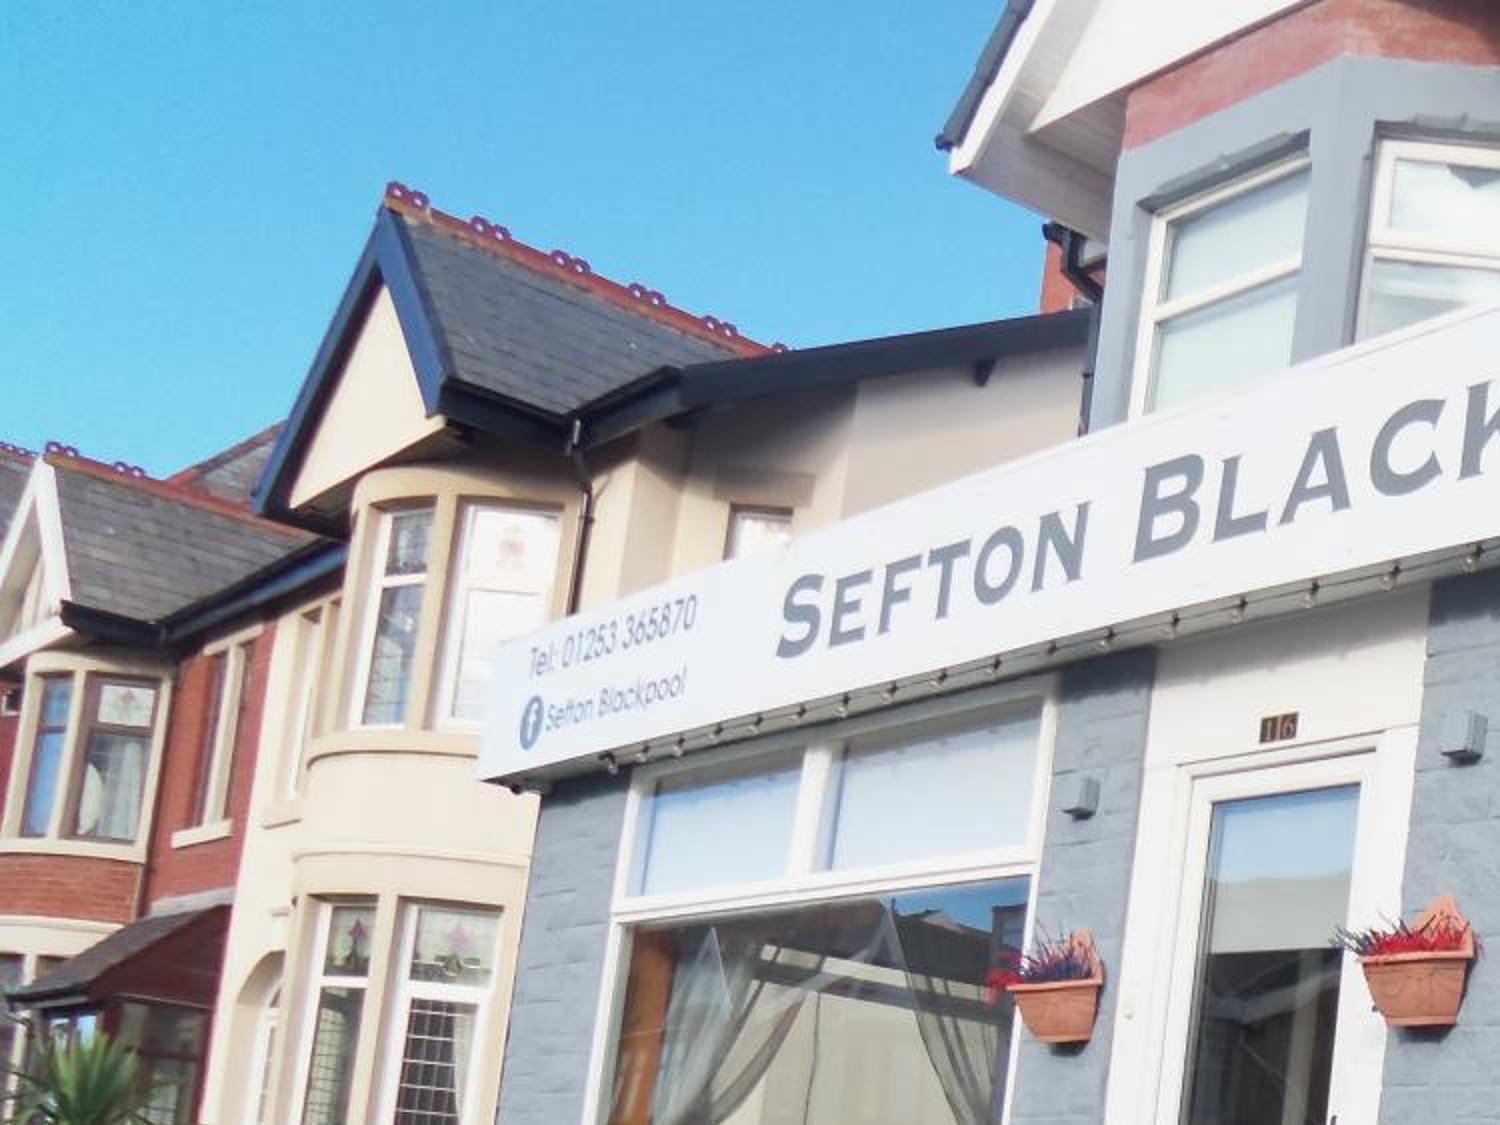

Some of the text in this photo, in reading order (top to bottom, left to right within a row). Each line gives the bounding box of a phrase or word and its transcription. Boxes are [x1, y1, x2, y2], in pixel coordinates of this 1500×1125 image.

[776, 500, 1091, 659] SEFTON
[531, 594, 698, 677] Tel: 01253 365870
[545, 696, 593, 731] Sefton
[597, 663, 688, 717] Blackpool
[1263, 715, 1297, 741] 16
